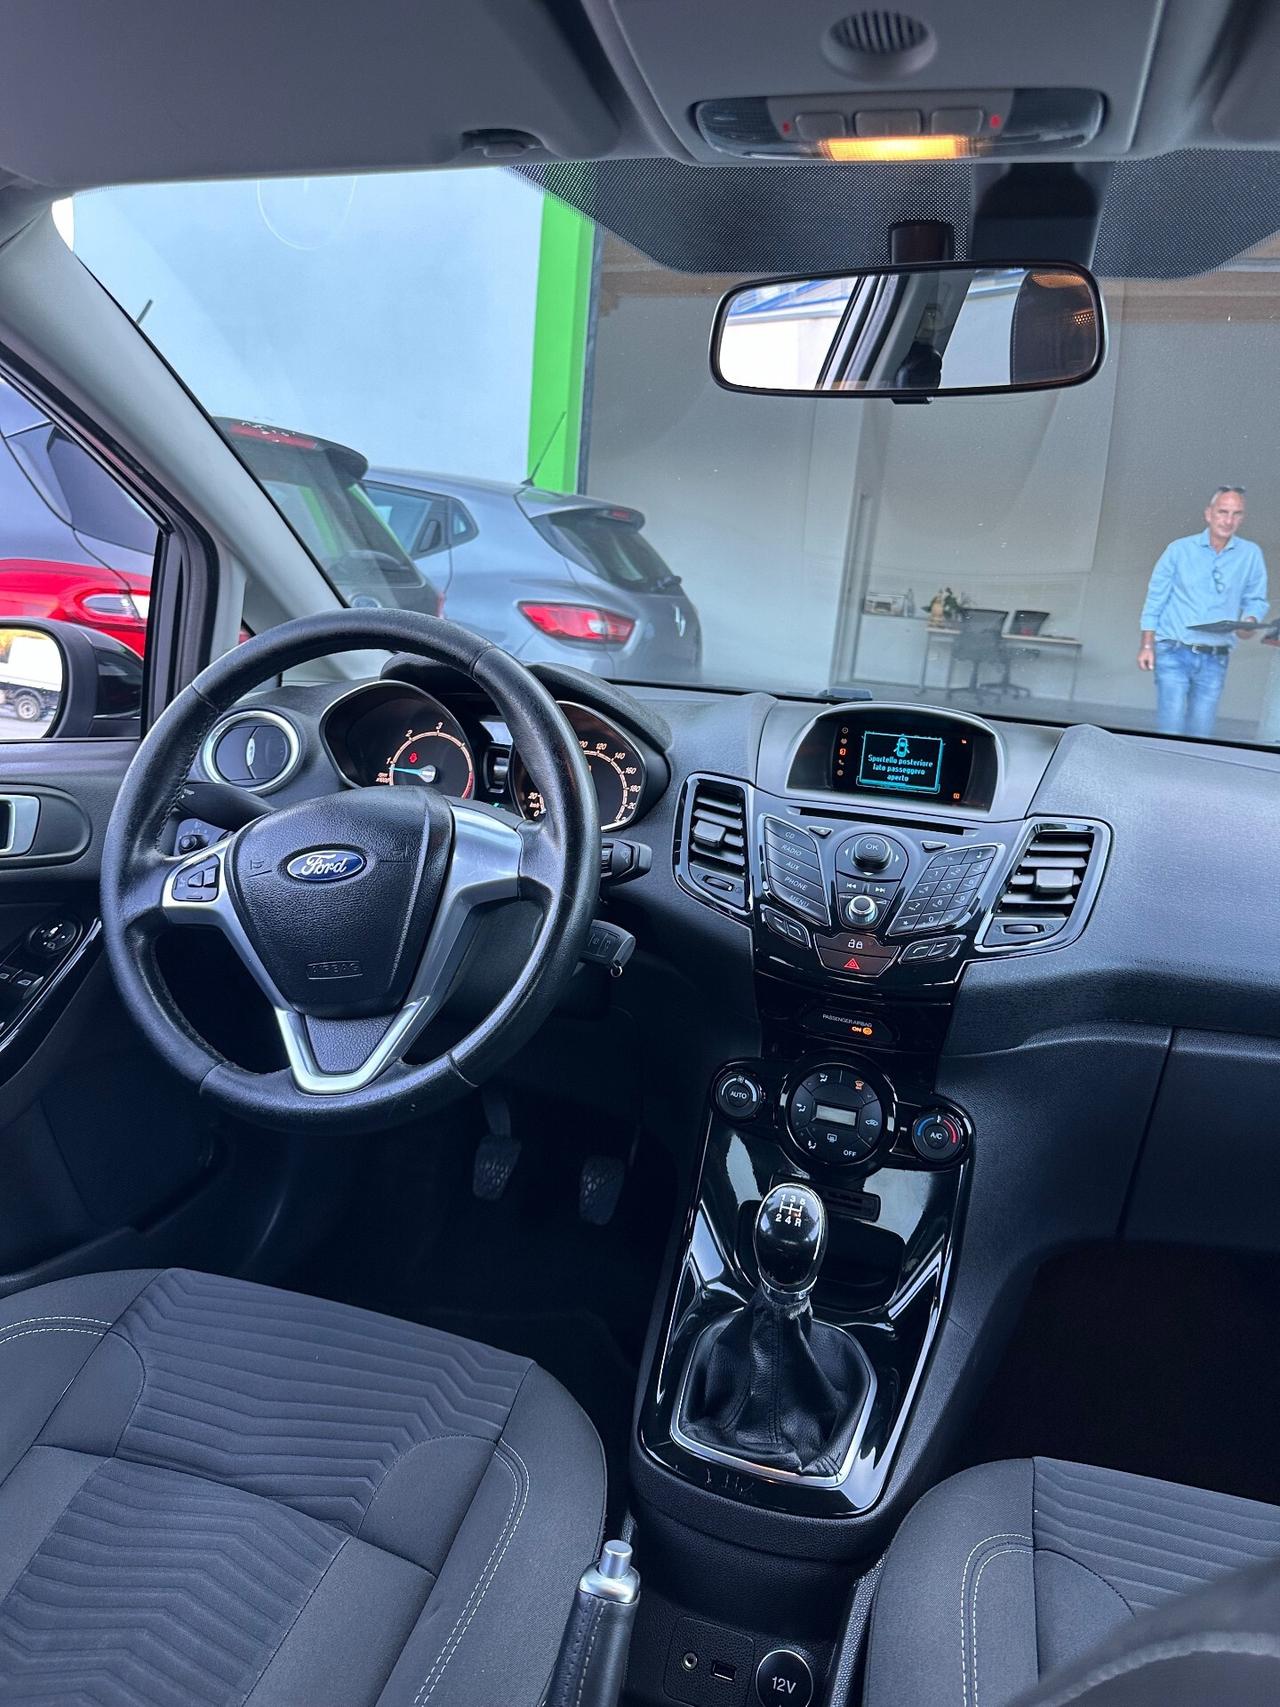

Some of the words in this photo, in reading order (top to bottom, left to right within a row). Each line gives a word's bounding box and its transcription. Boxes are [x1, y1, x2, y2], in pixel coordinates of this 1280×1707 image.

[436, 721, 443, 730] 3
[405, 729, 413, 737] 2
[595, 742, 607, 750] 120
[614, 752, 626, 760] 140
[868, 754, 898, 764] Sportello
[898, 758, 934, 768] posteriore
[625, 766, 637, 775] 160
[872, 763, 886, 772] lato
[887, 766, 926, 776] passeggero
[887, 774, 910, 783] aperto
[527, 792, 538, 800] 20
[785, 831, 795, 840] CD
[782, 844, 802, 856] RADIO
[865, 843, 878, 851] OK
[300, 853, 347, 876] Ford
[785, 861, 800, 871] AUX
[784, 876, 808, 891] PHONE
[790, 895, 809, 907] MENU
[822, 1013, 853, 1025] PASSENGER
[853, 1019, 873, 1028] AIRBAG
[730, 1090, 748, 1099] AUTO
[930, 1131, 943, 1140] A/C
[843, 1149, 857, 1158] OFF
[775, 1213, 782, 1222] 2
[784, 1215, 791, 1225] 4
[794, 1217, 801, 1228] R
[772, 1676, 797, 1694] 12V
